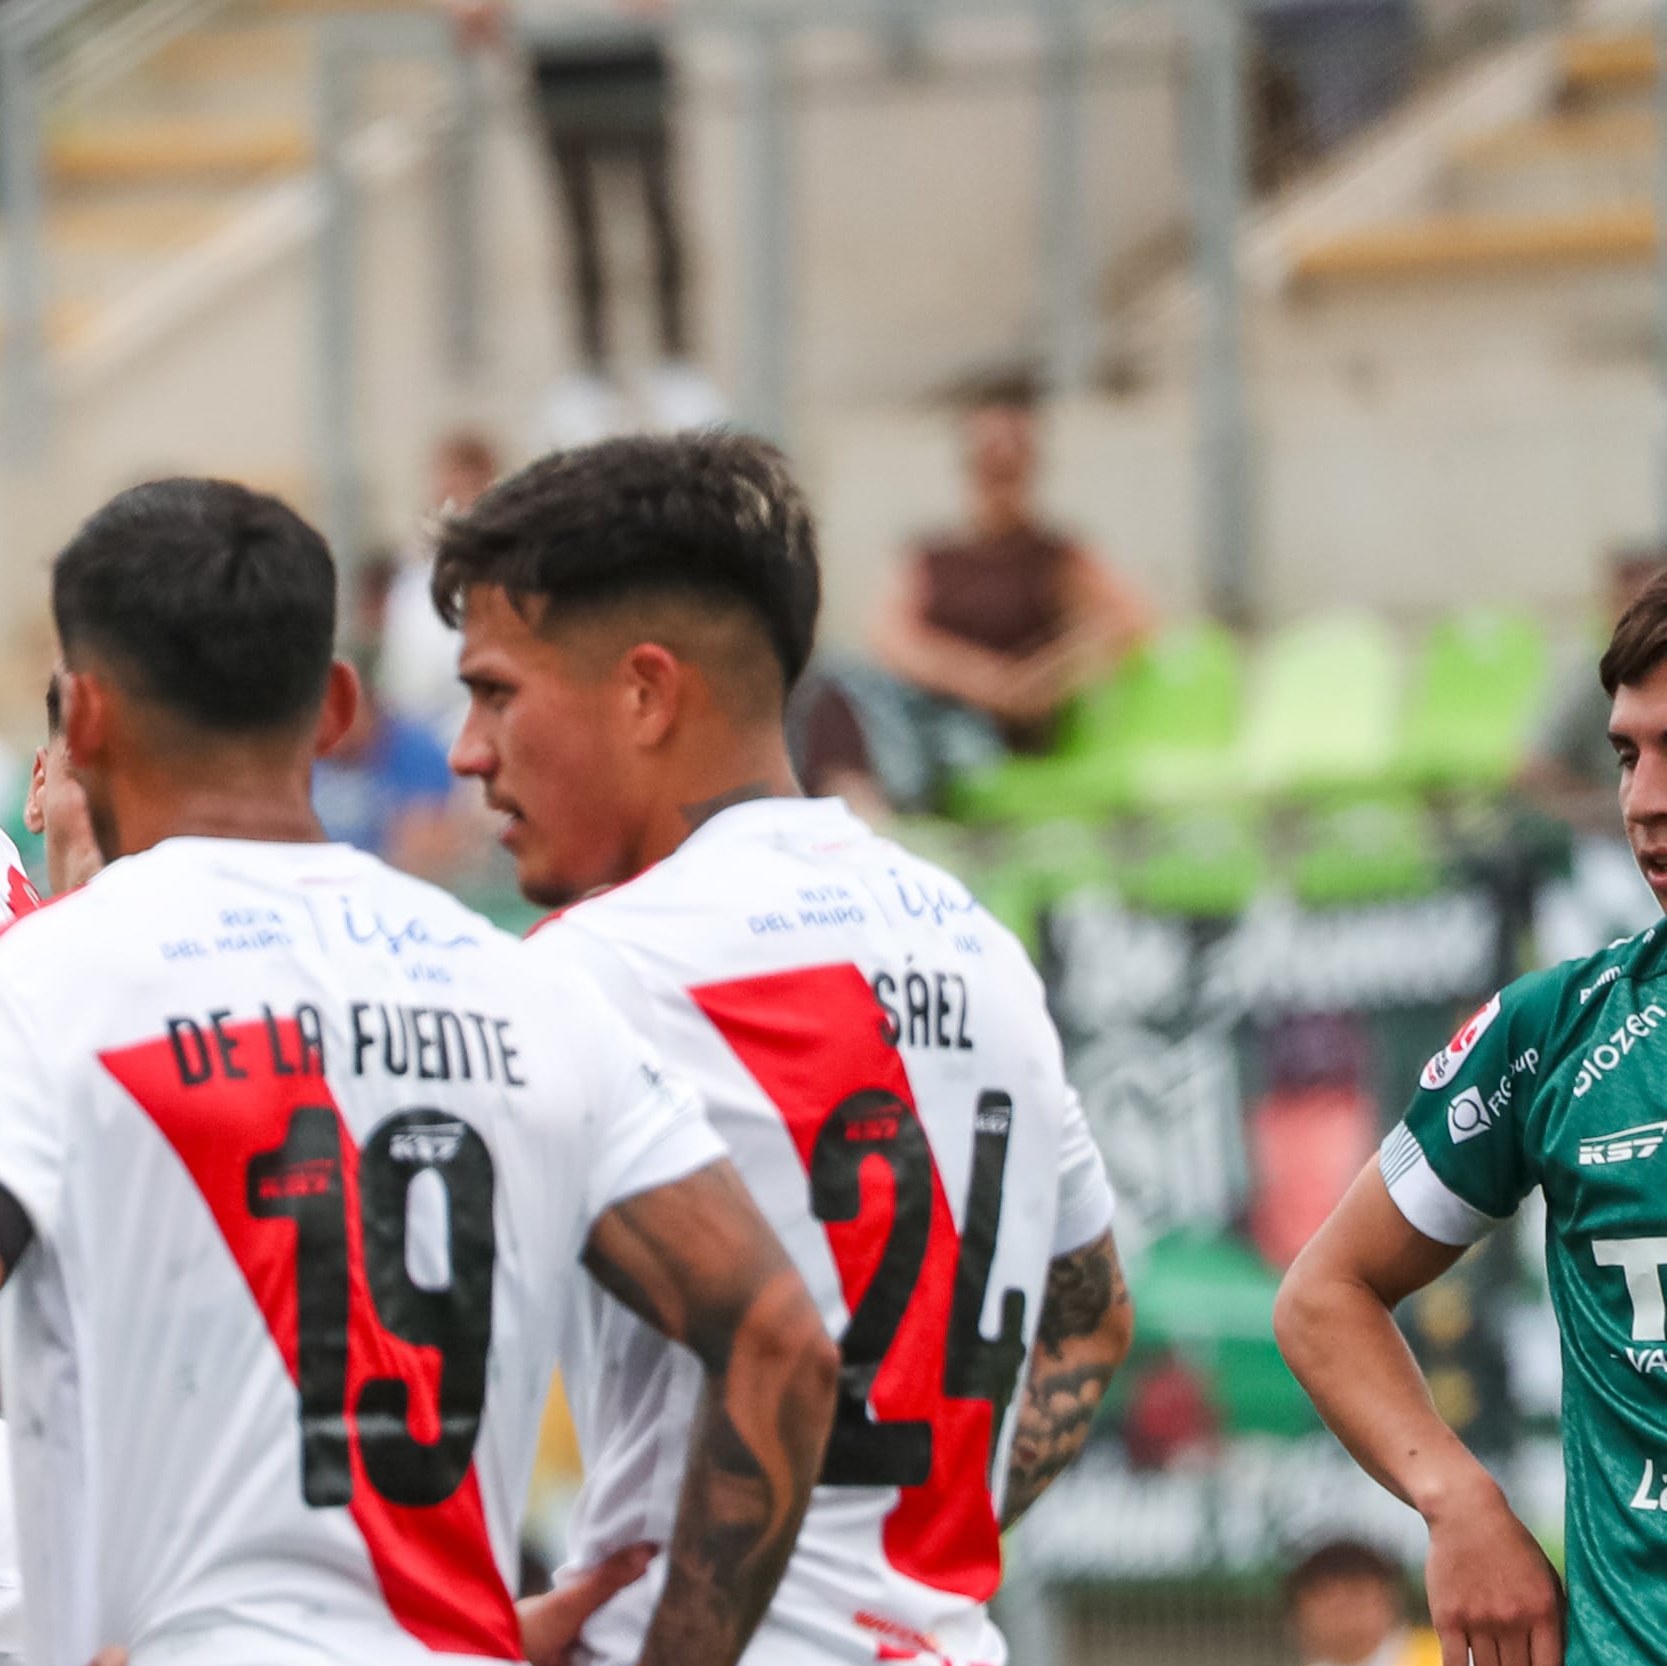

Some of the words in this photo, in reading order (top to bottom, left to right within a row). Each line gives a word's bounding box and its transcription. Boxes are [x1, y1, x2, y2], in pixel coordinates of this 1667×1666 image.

[167, 1005, 248, 1087] DE
[264, 1000, 326, 1077] LA
[352, 1001, 527, 1087] FUENTE
[872, 954, 974, 1050] SÁEZ
[1579, 1136, 1664, 1165] KS7
[247, 1104, 496, 1510] 19
[809, 1089, 1027, 1488] 24
